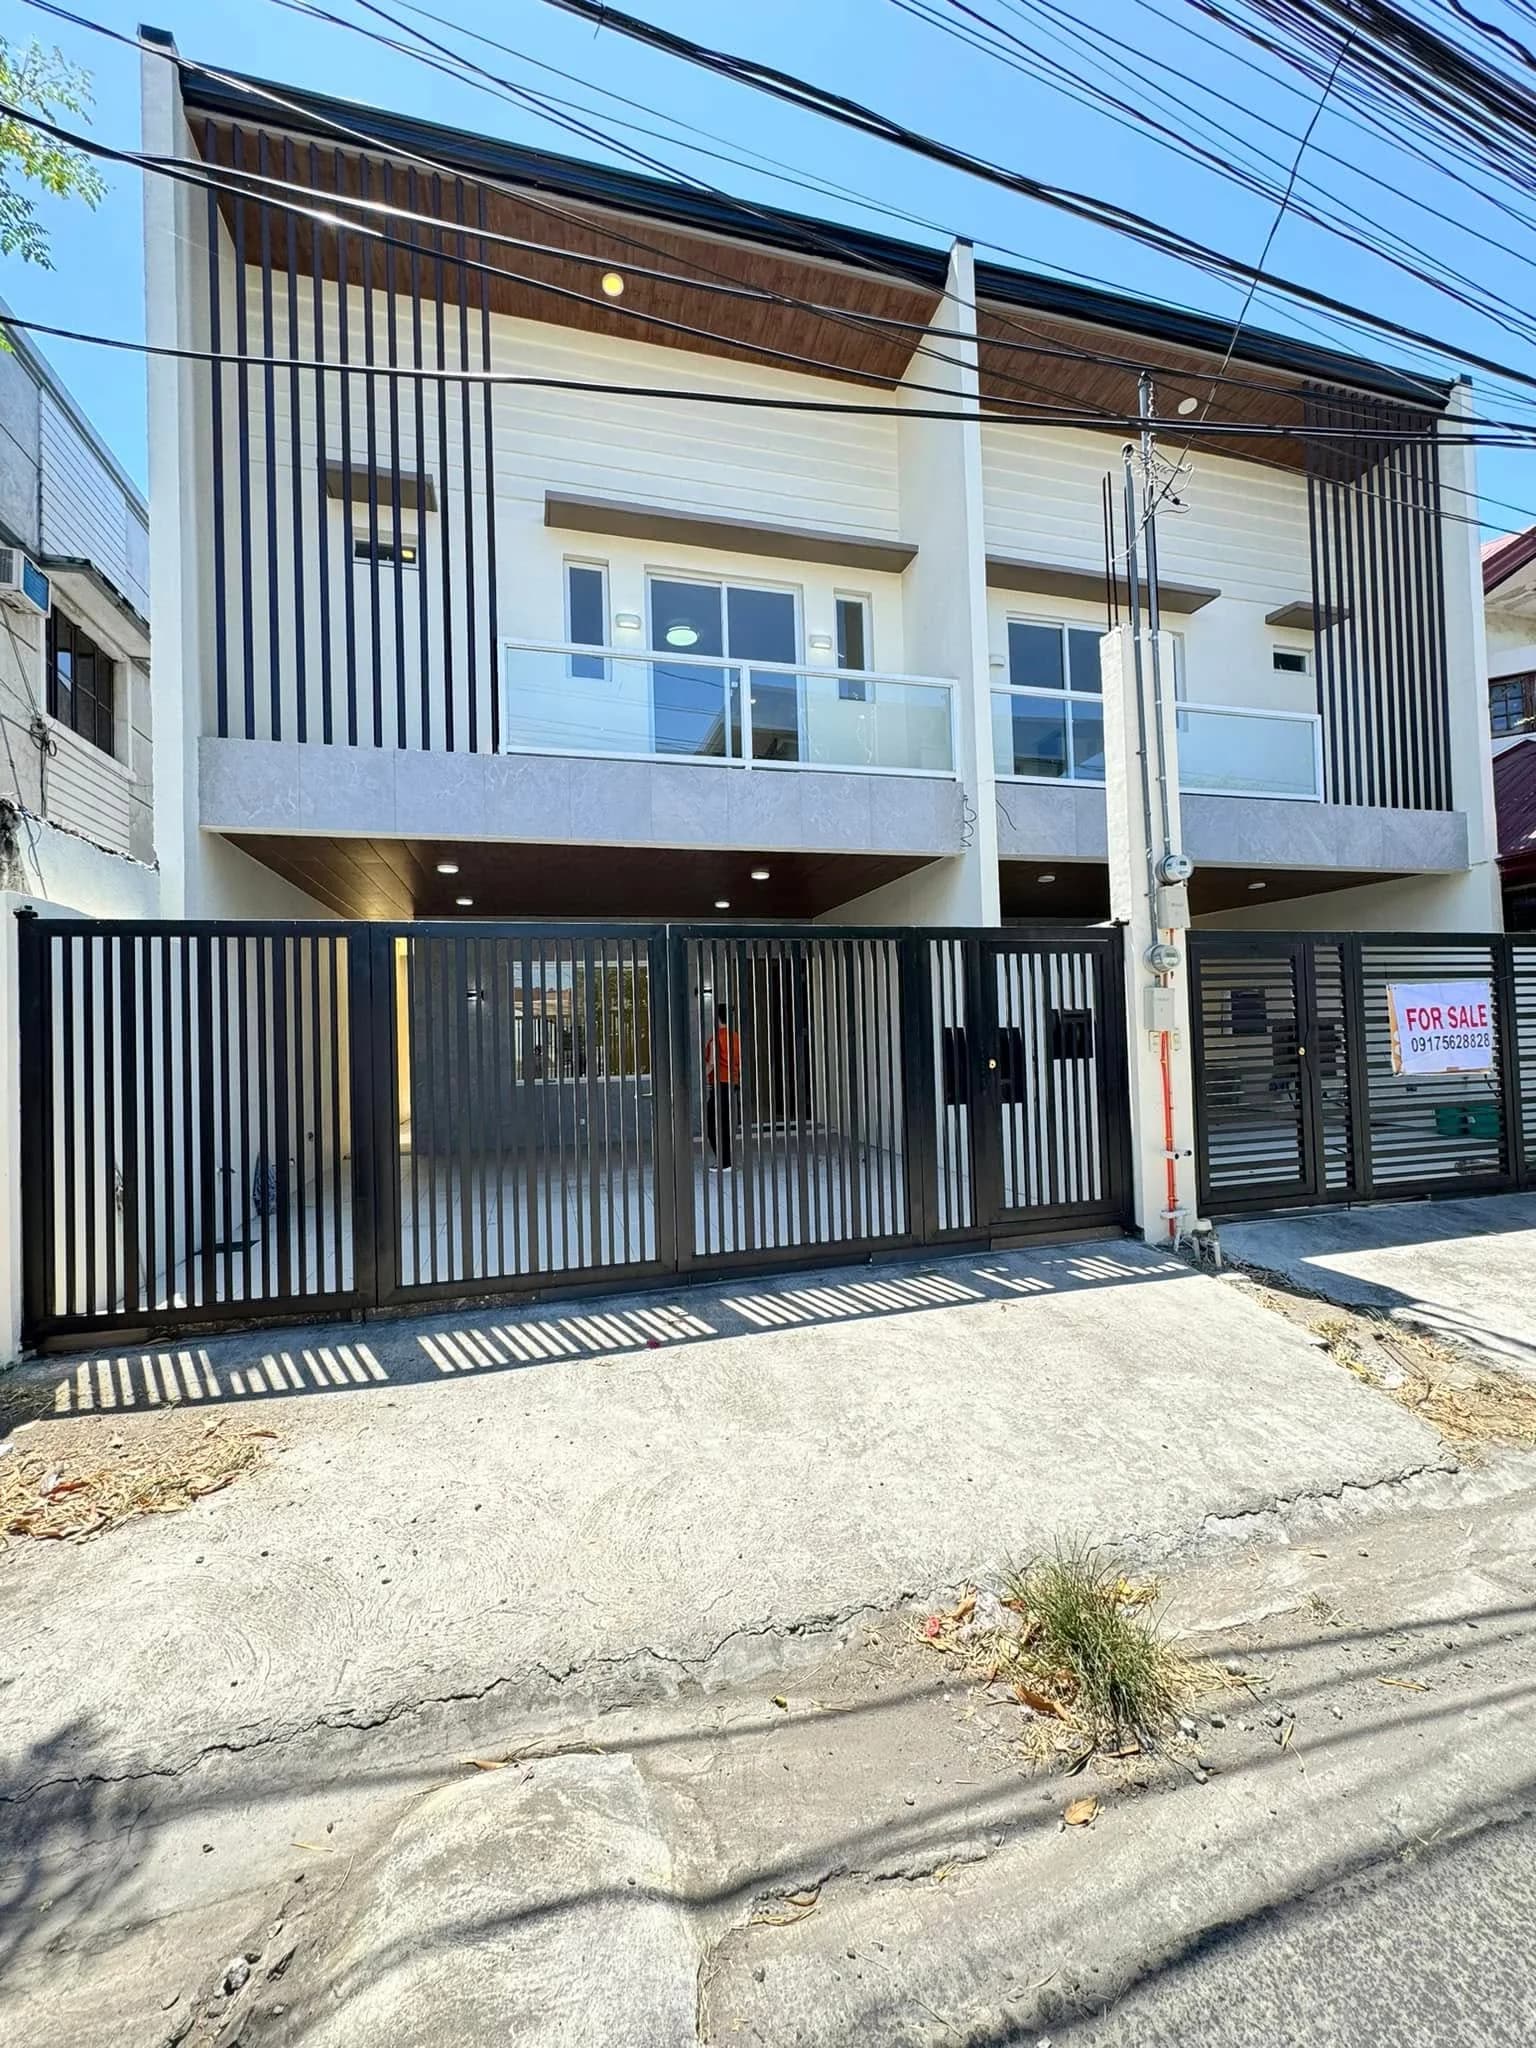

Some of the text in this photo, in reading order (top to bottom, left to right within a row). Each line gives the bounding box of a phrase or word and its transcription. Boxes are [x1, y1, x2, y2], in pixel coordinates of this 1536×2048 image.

[1406, 1004, 1488, 1031] FOR SALE
[1411, 1033, 1490, 1052] 09175628828
